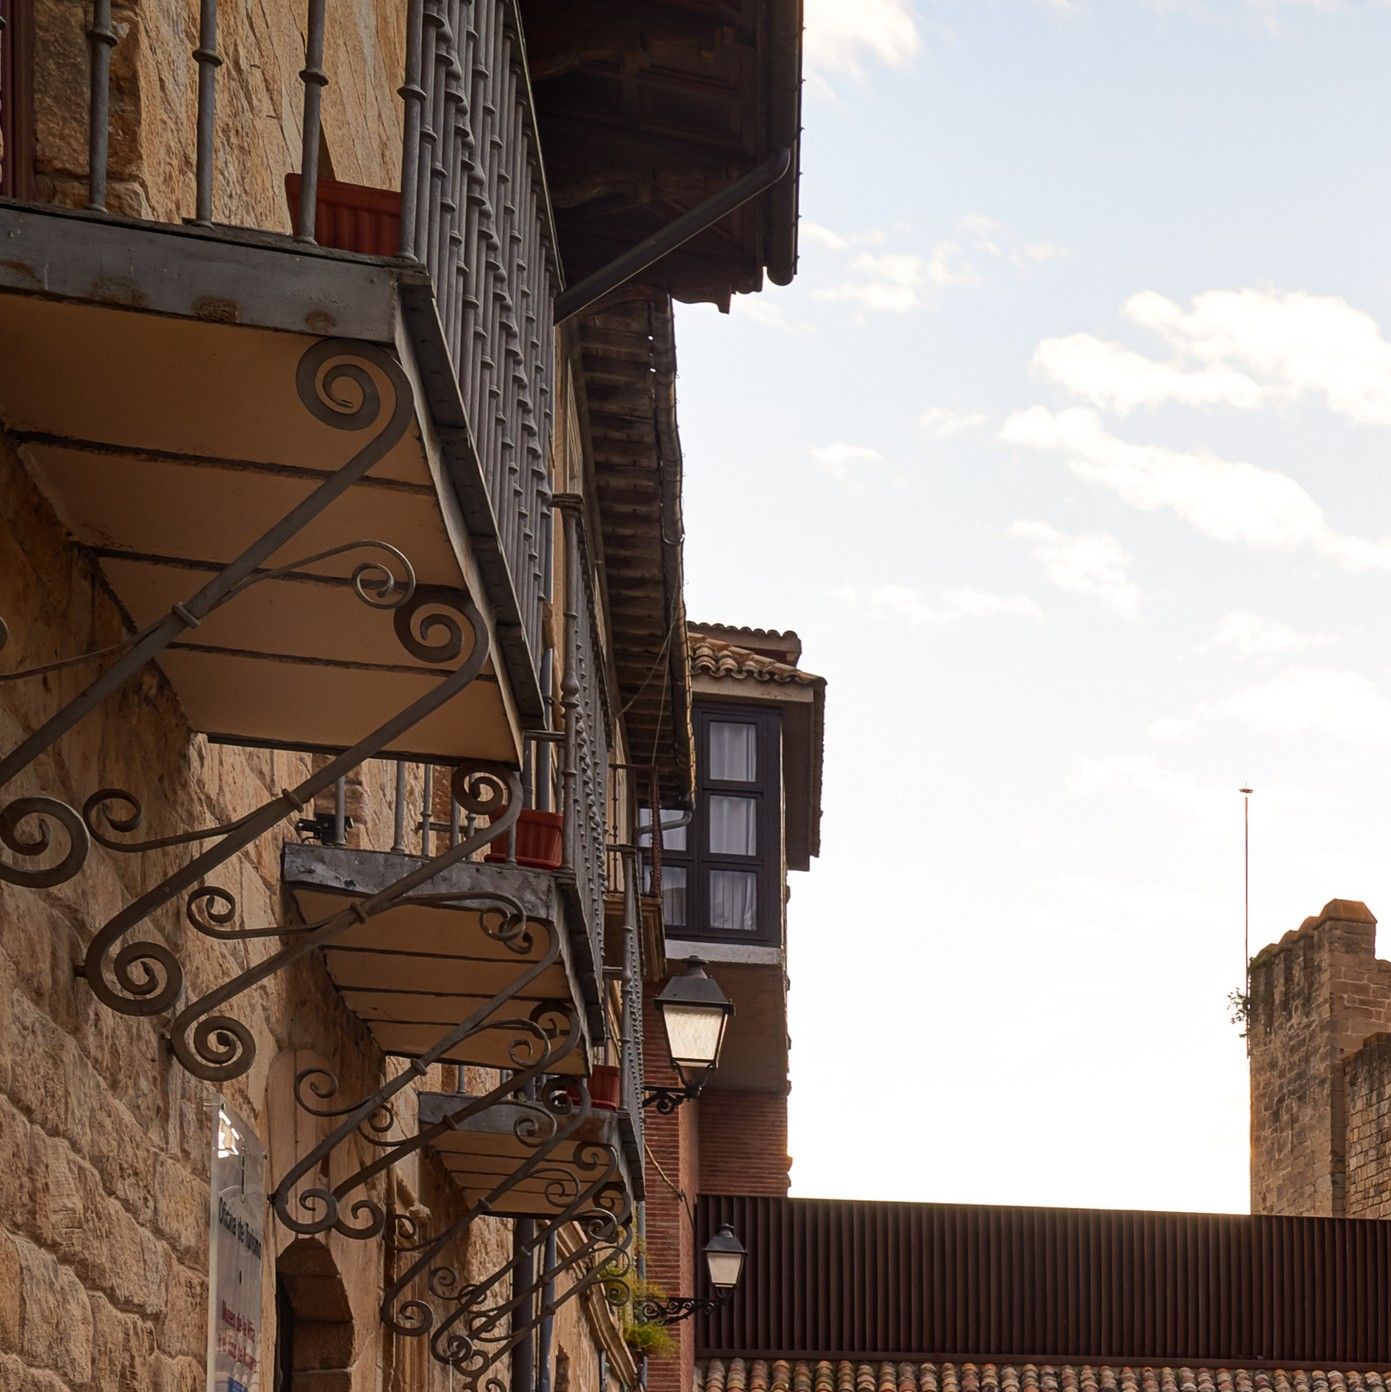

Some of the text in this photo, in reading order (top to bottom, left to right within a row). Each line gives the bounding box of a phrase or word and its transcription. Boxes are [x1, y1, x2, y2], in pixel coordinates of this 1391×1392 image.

[219, 1196, 262, 1260] Oficina de Turismo
